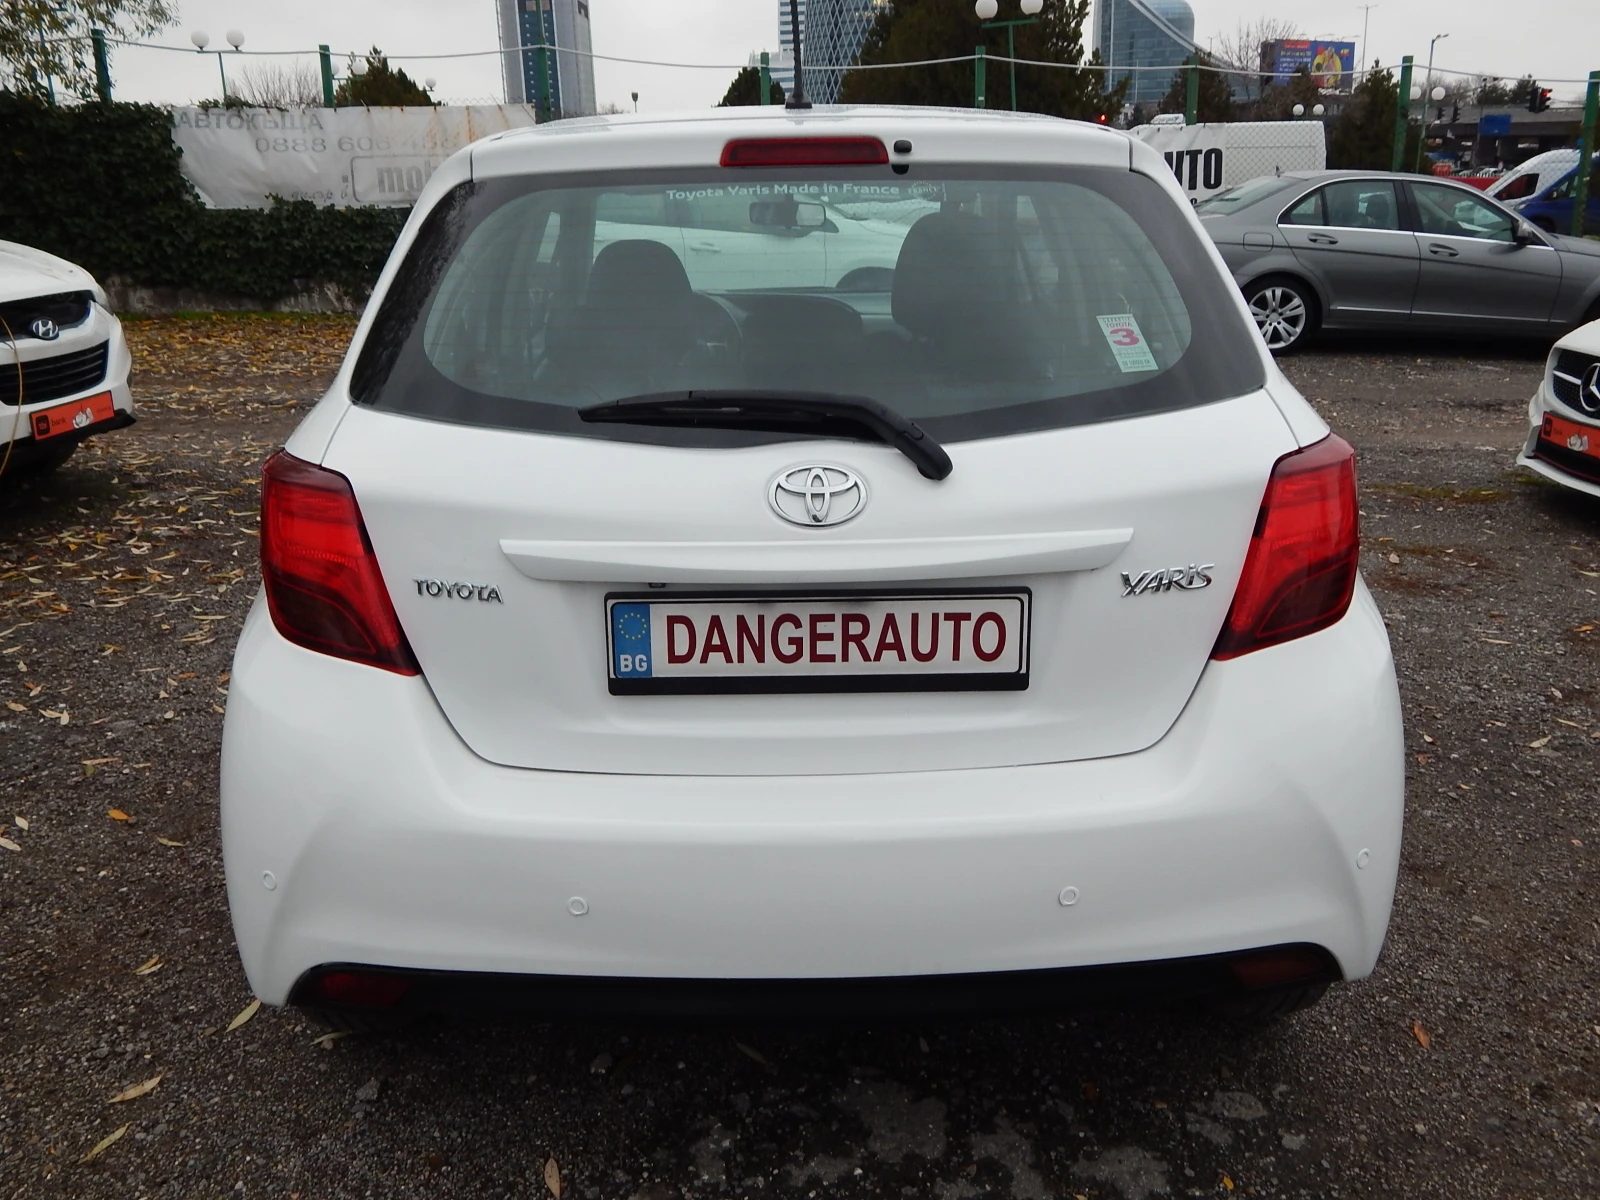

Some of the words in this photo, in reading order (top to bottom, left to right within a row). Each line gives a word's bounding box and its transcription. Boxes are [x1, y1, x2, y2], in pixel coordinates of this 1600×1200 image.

[256, 137, 327, 153] 0888
[666, 188, 723, 201] Toyota
[728, 185, 769, 196] Yaris
[774, 183, 818, 195] Made
[823, 182, 838, 194] in
[842, 183, 900, 195] France
[1110, 328, 1139, 346] 3
[413, 578, 504, 604] TOYOTA
[666, 611, 1007, 664] DANGERAUTO
[620, 654, 648, 672] BG
